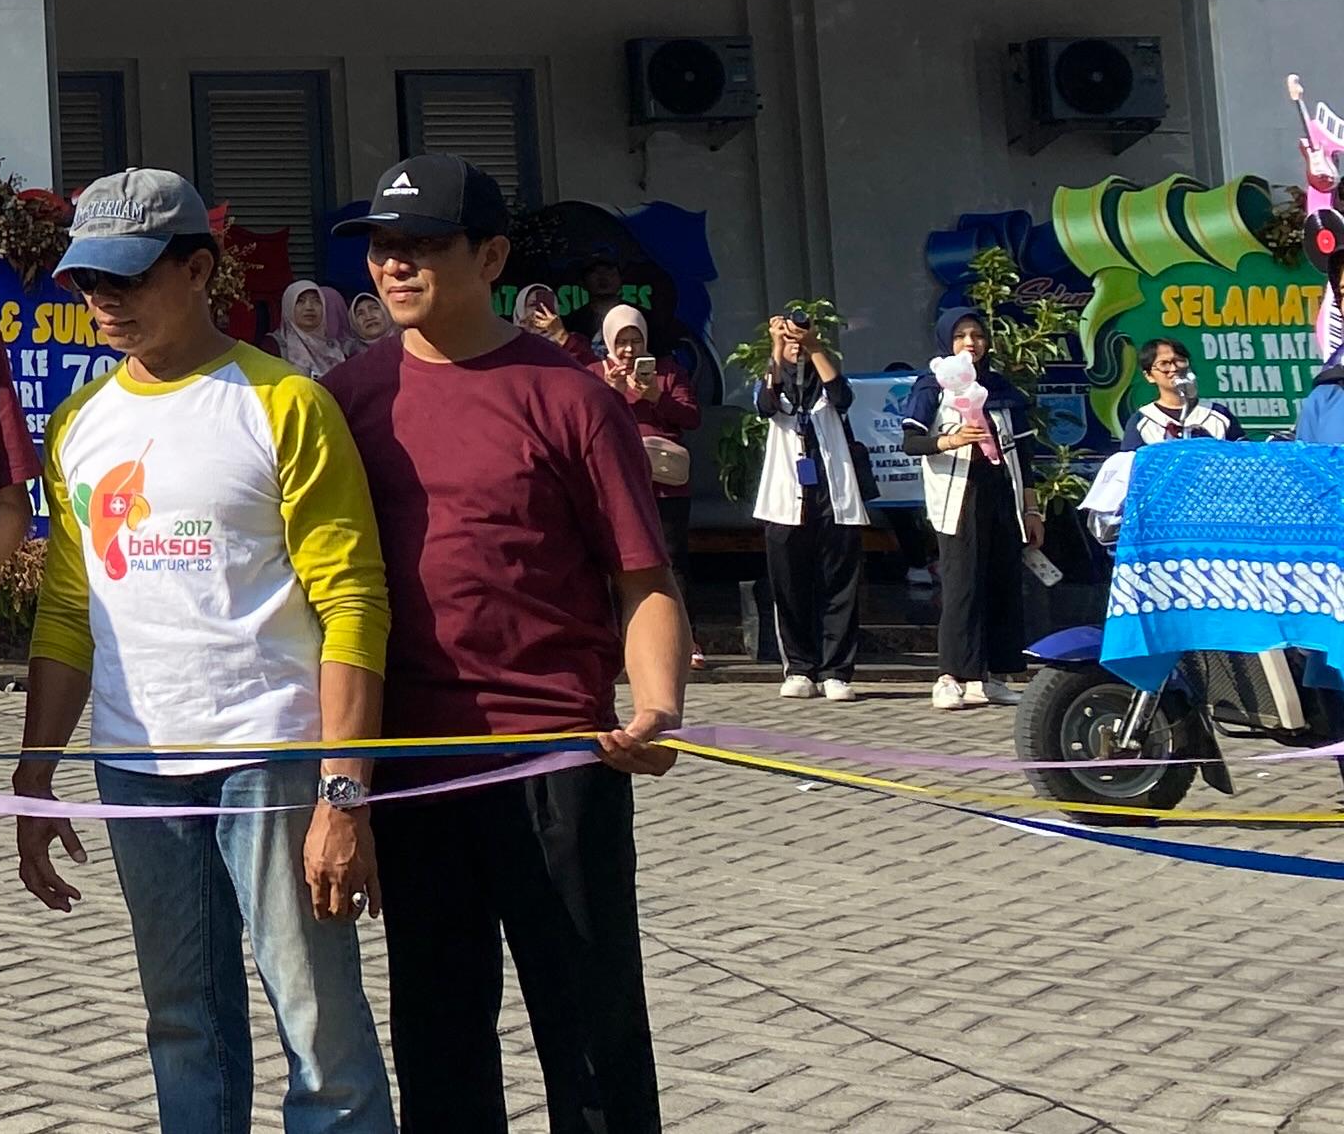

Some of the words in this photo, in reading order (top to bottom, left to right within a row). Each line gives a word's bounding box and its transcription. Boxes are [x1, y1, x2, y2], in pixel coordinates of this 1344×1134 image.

[1161, 284, 1323, 327] SELAMAT
[1201, 332, 1256, 361] DIES
[1216, 364, 1284, 393] SMAN
[173, 520, 213, 536] 2017
[128, 535, 212, 556] baksos
